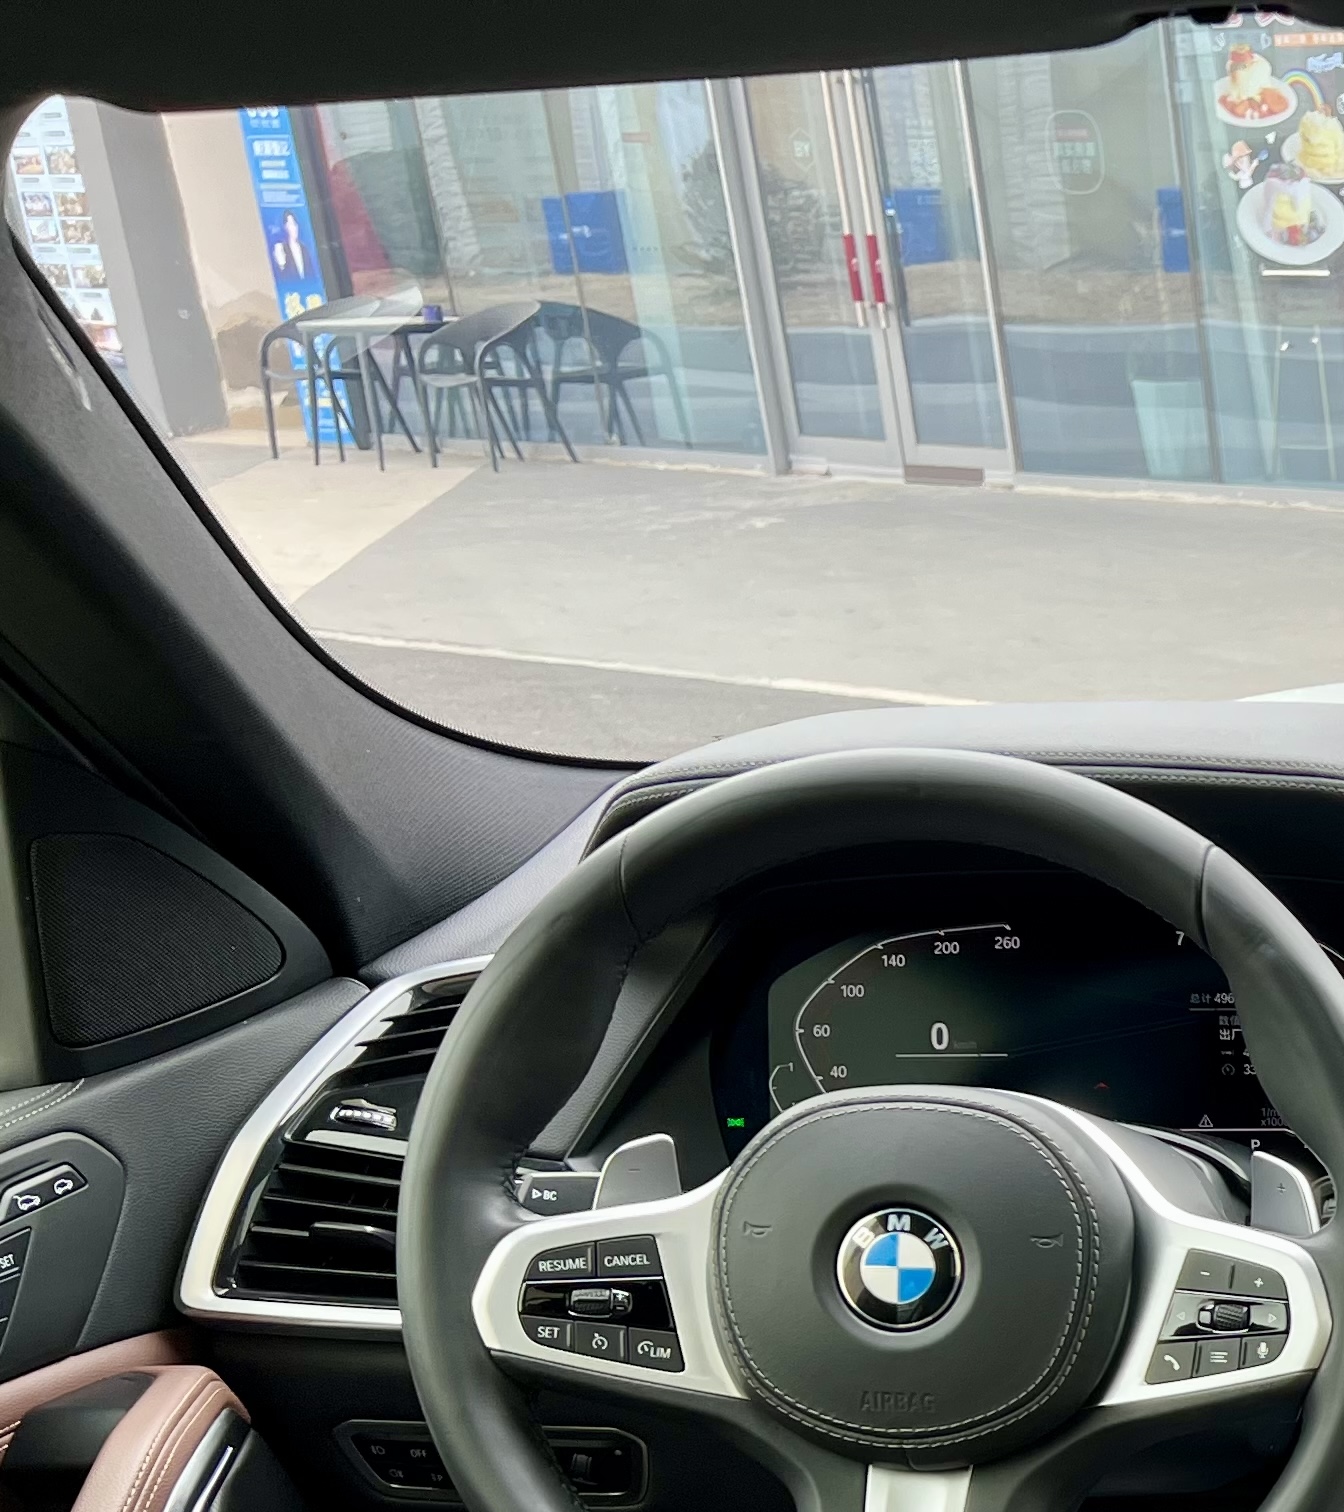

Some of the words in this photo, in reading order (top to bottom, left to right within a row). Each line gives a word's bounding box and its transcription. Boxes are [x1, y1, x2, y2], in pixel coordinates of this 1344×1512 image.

[994, 936, 1020, 950] 260
[1175, 931, 1185, 946] 7
[934, 941, 960, 955] 200
[881, 954, 906, 968] 140
[840, 984, 865, 998] 100
[812, 1024, 831, 1038] 60
[930, 1022, 950, 1050] 0
[829, 1065, 848, 1079] 40
[1250, 1139, 1261, 1150] P
[542, 1190, 558, 1201] BC
[851, 1213, 950, 1250] BMW
[538, 1257, 587, 1272] RESUME
[604, 1254, 650, 1268] CANCEL
[537, 1326, 560, 1339] SET
[649, 1346, 672, 1359] LIM
[859, 1390, 936, 1413] AIRBAG
